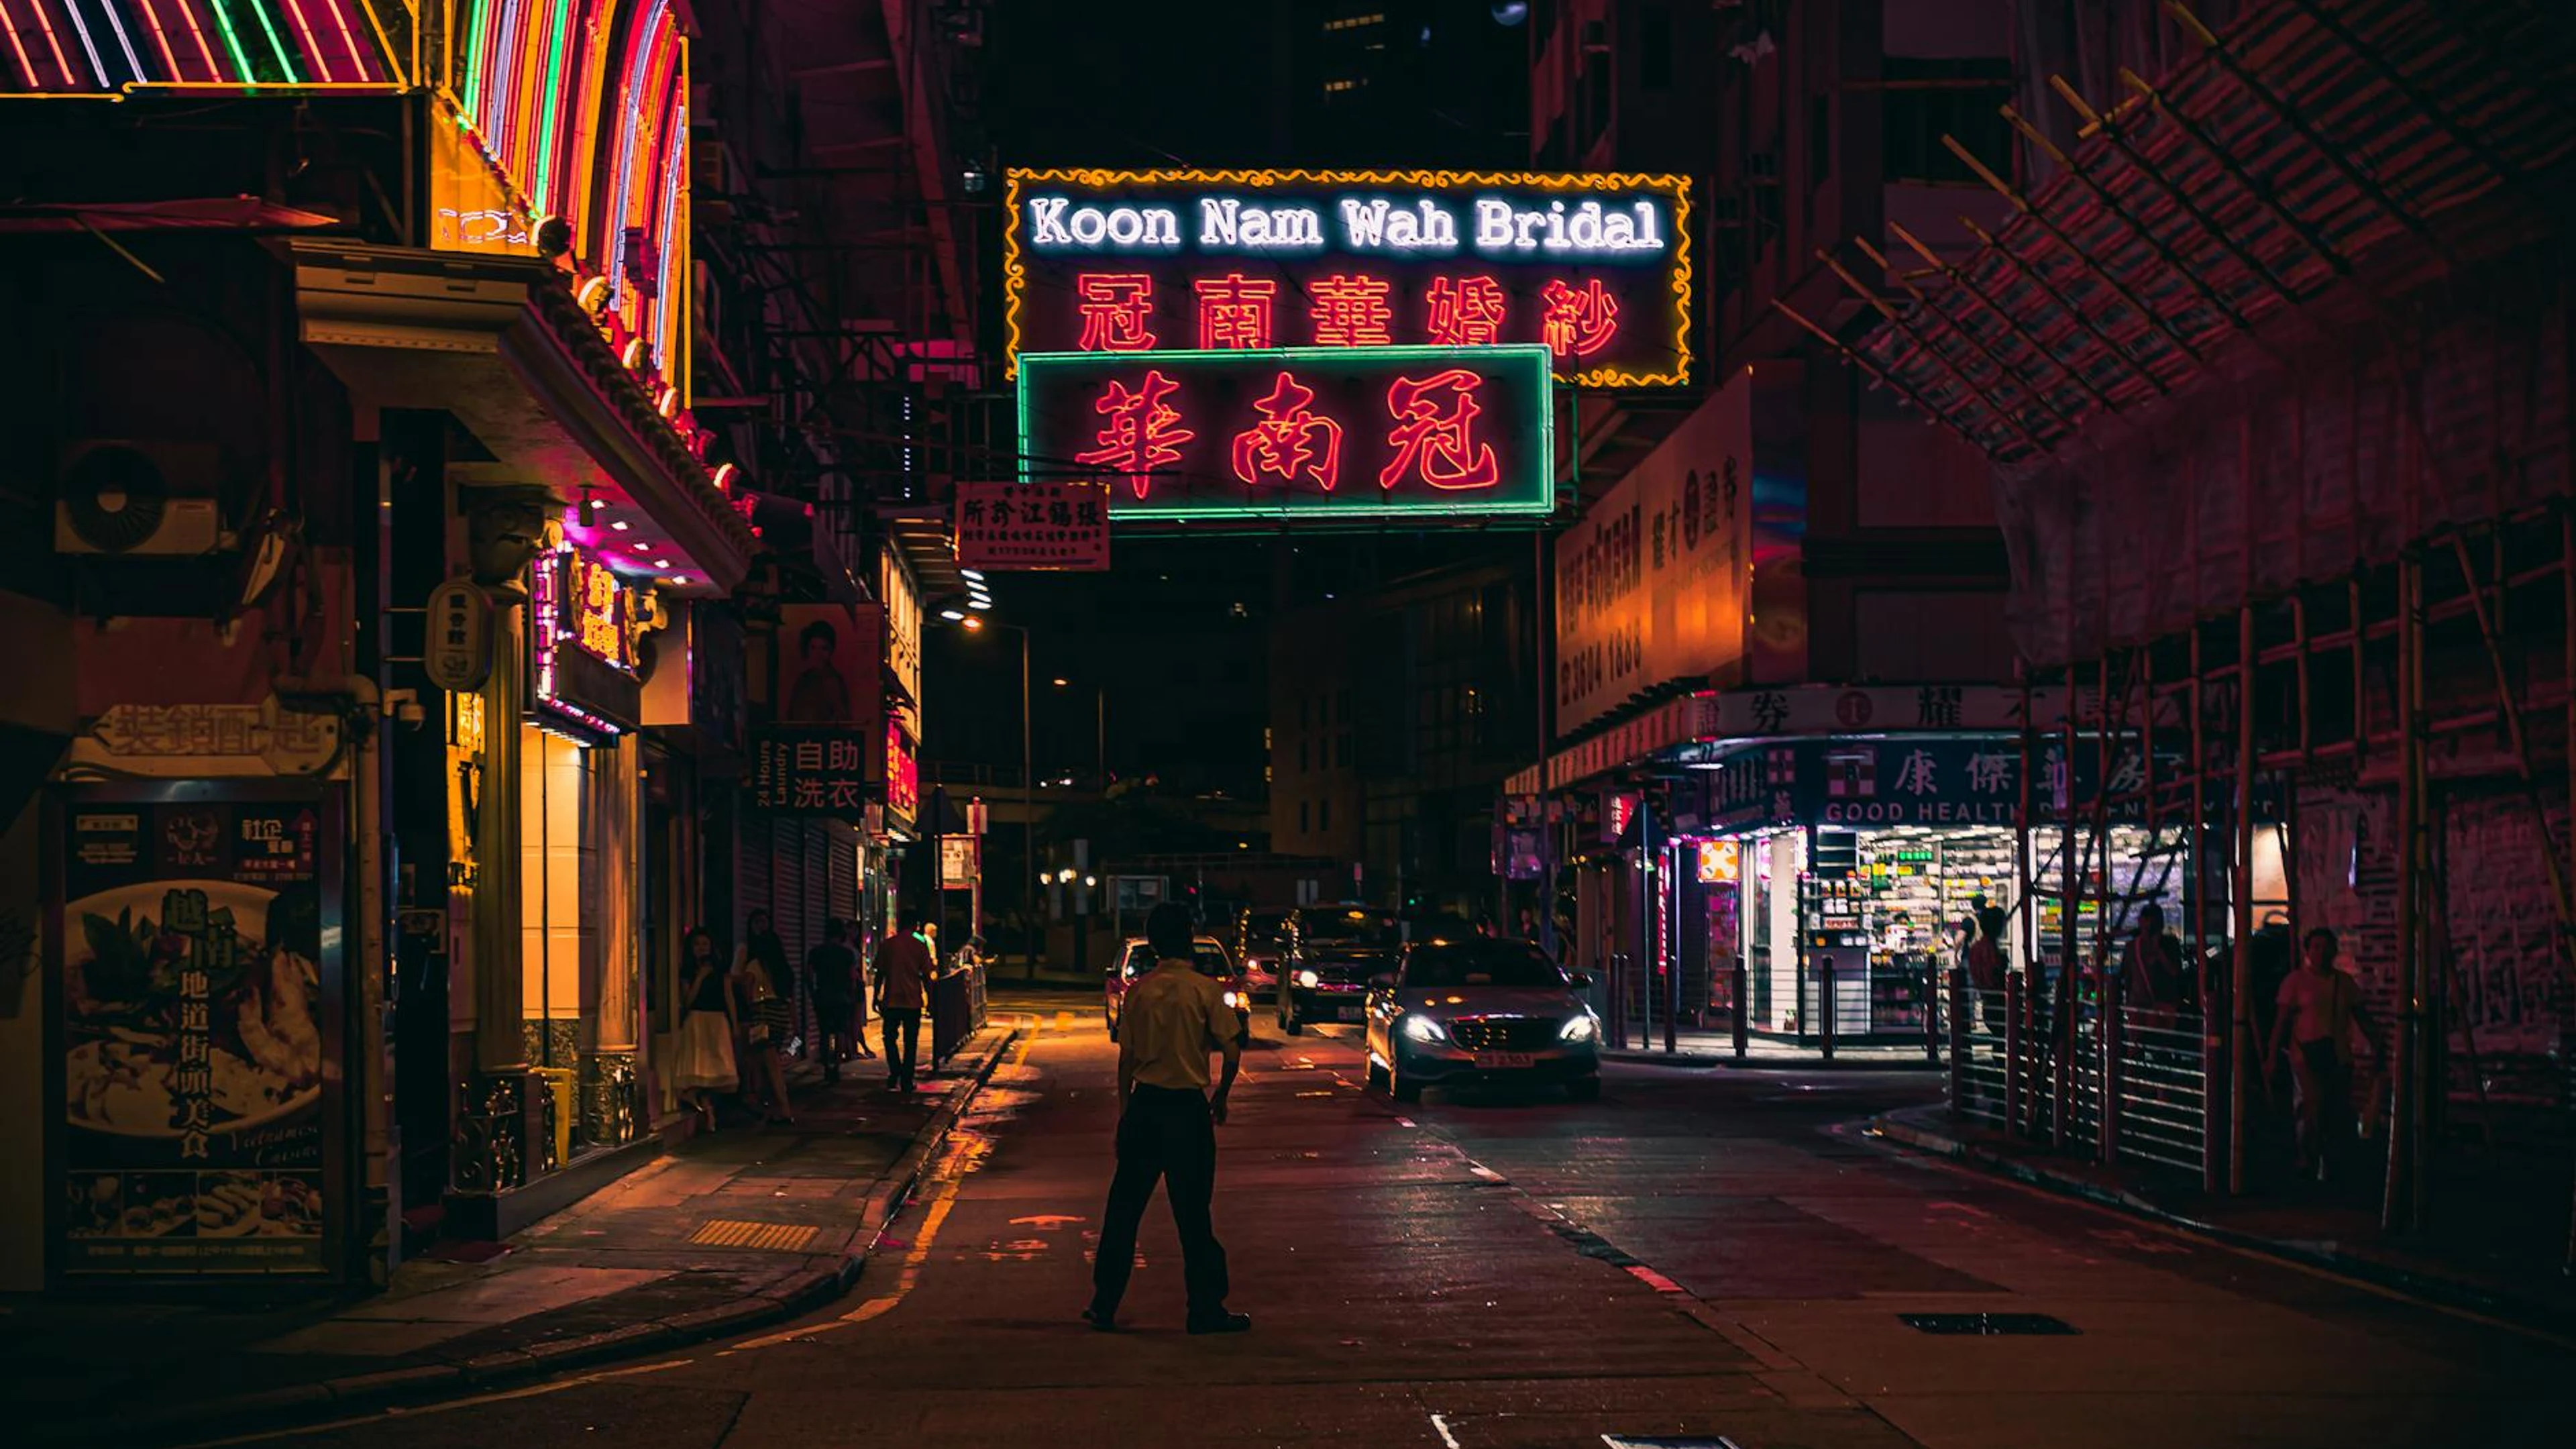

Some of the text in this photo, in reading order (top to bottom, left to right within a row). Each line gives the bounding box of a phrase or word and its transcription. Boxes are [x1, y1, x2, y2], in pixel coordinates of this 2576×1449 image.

[1030, 197, 1664, 250] Koon Nam Wah Bridal
[1077, 273, 1619, 356] 冠南華婚紗
[757, 740, 770, 808] 24 Hours
[774, 743, 790, 805] Laundry
[794, 739, 859, 771] 自助
[793, 777, 859, 809] 洗衣
[1825, 802, 1904, 822] GOOD
[178, 970, 211, 1161] 地道街頭美食
